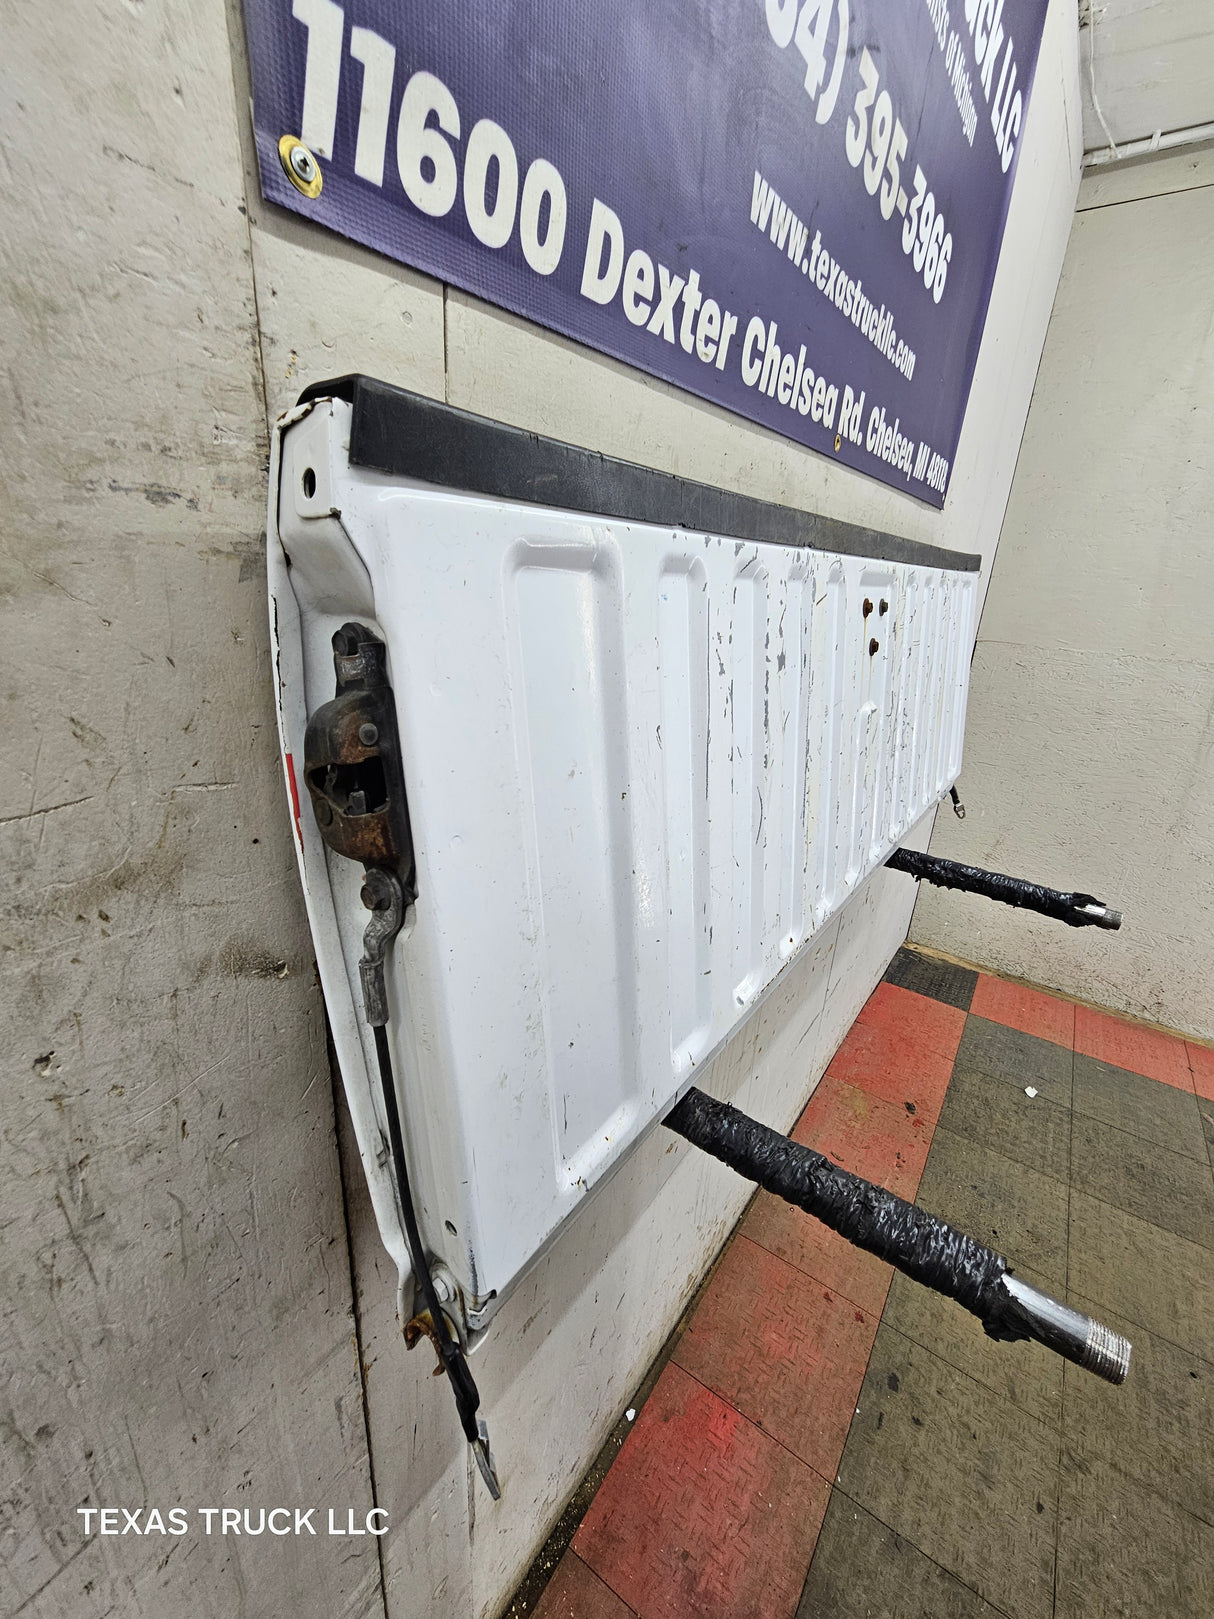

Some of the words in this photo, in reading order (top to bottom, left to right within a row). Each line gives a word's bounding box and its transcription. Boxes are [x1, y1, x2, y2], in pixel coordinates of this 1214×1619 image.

[945, 30, 959, 77] of
[951, 41, 978, 148] Michigan
[991, 36, 1022, 173] LLC
[292, 0, 567, 275] 11600
[580, 197, 738, 371] Dexter
[741, 315, 838, 430] Chelsea
[837, 384, 865, 446] Rd.
[866, 406, 914, 481] Chelsea,
[912, 441, 930, 481] MI
[926, 452, 949, 493] 48118
[846, 45, 952, 304] 395-3966
[750, 170, 916, 381] www.texastruckllc.com
